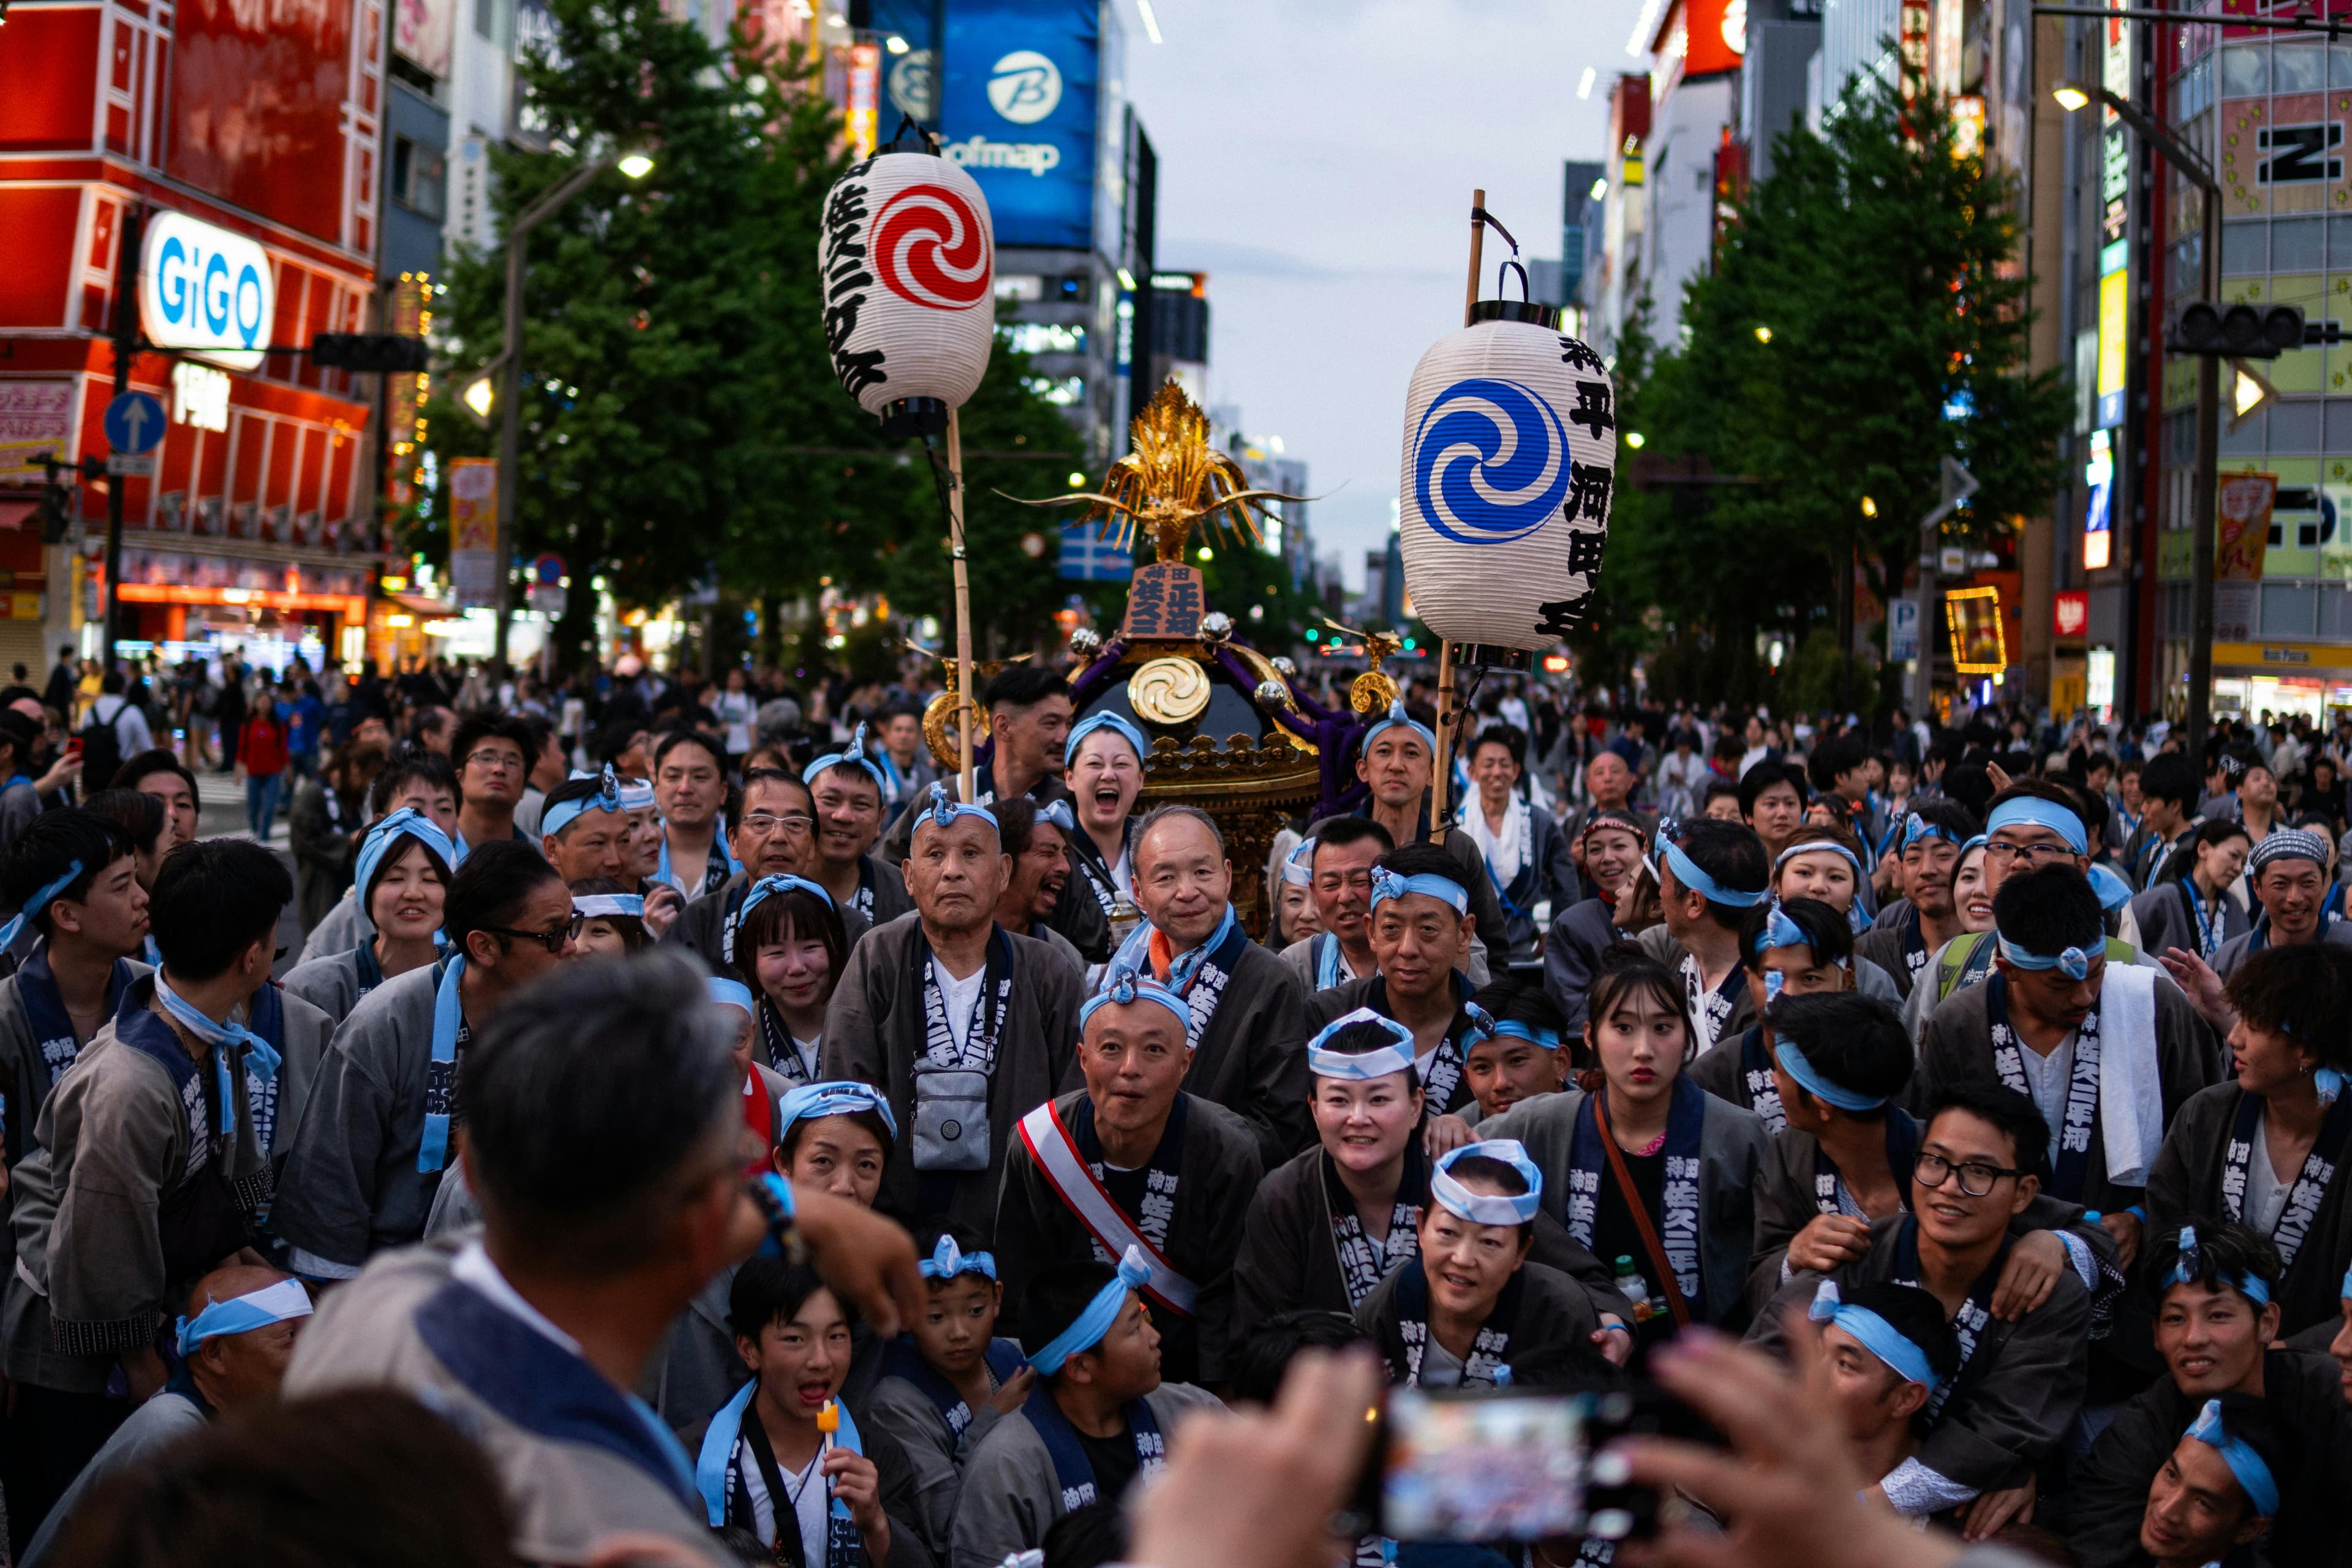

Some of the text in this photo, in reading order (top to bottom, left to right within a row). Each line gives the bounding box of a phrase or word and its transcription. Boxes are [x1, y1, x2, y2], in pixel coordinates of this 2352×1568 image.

[159, 237, 262, 349] GiGO
[1200, 962, 1228, 991] 神田
[1709, 992, 1732, 1019] 神田
[42, 1036, 78, 1060] 神田
[1148, 1169, 1179, 1194] 神田
[1570, 1168, 1599, 1193] 神田
[1667, 1156, 1700, 1180] 神田
[2304, 1154, 2335, 1183] 神田
[1956, 1297, 1989, 1332] 神田
[1476, 1327, 1509, 1352] 神田
[946, 1401, 973, 1432] 神田
